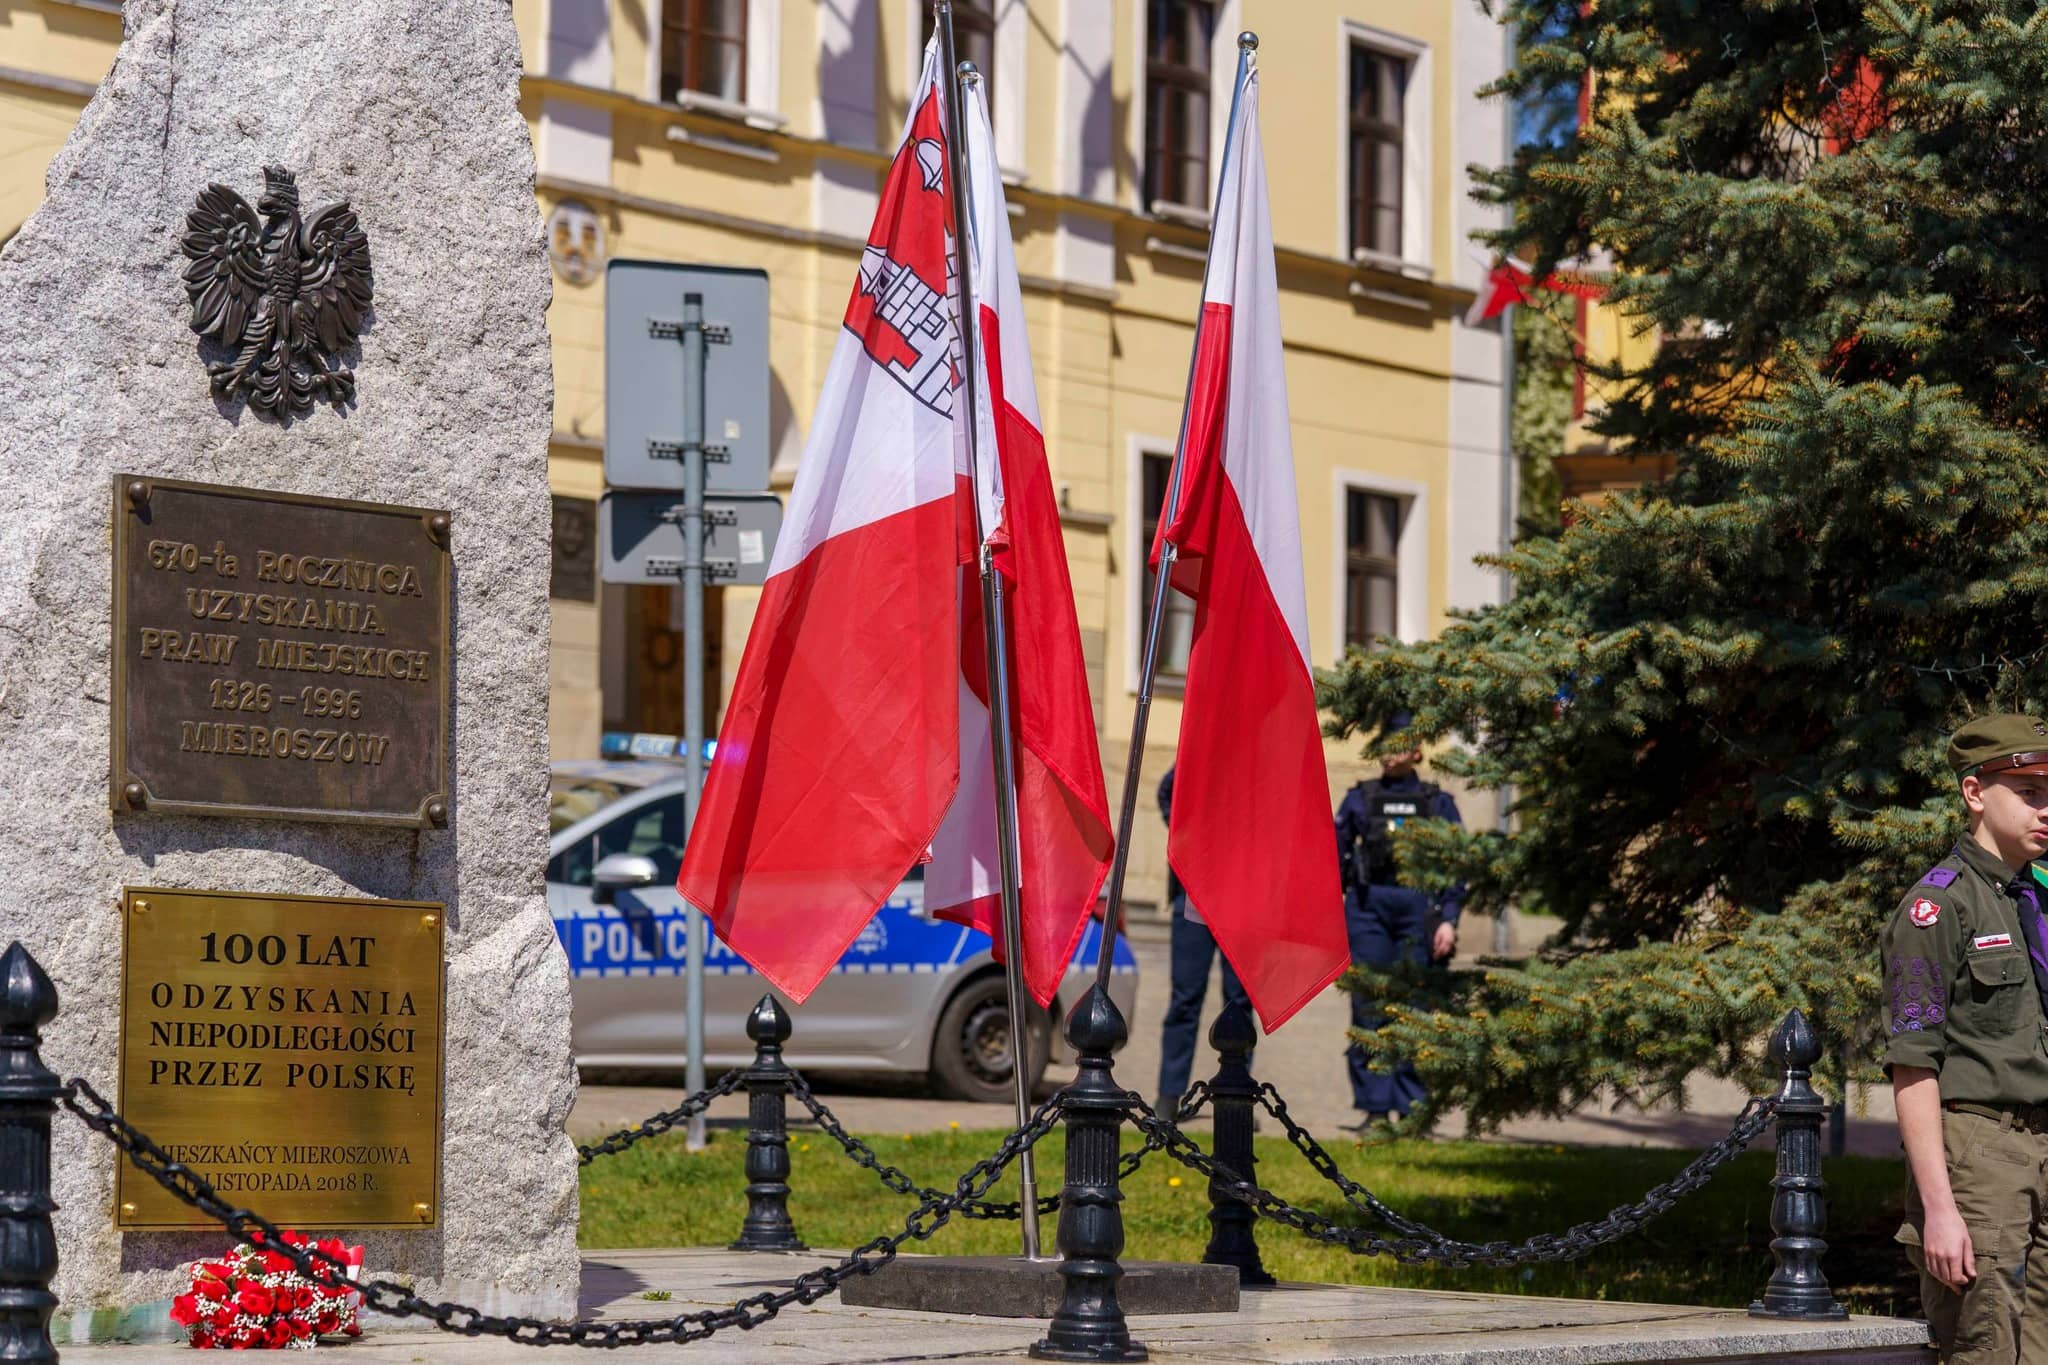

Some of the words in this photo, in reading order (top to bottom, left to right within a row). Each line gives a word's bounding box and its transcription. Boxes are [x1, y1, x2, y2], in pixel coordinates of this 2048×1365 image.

[148, 539, 240, 578] 670-ta
[257, 550, 423, 597] ROCZNICA
[186, 587, 386, 635] UZYSKANIA
[140, 627, 239, 666] PRAW
[256, 638, 431, 681] MIEJSKICH
[199, 932, 287, 965] 100
[296, 934, 376, 968] LAT
[151, 982, 417, 1017] ODZYSKANIA
[150, 1021, 416, 1053] NIEPODLEGŁOŚCI
[150, 1060, 263, 1088] PRZEZ
[285, 1063, 416, 1097] POLSKĘ
[282, 1145, 411, 1165] MIEROSZOWA
[316, 1172, 358, 1191] 2018
[362, 1173, 379, 1191] R.
